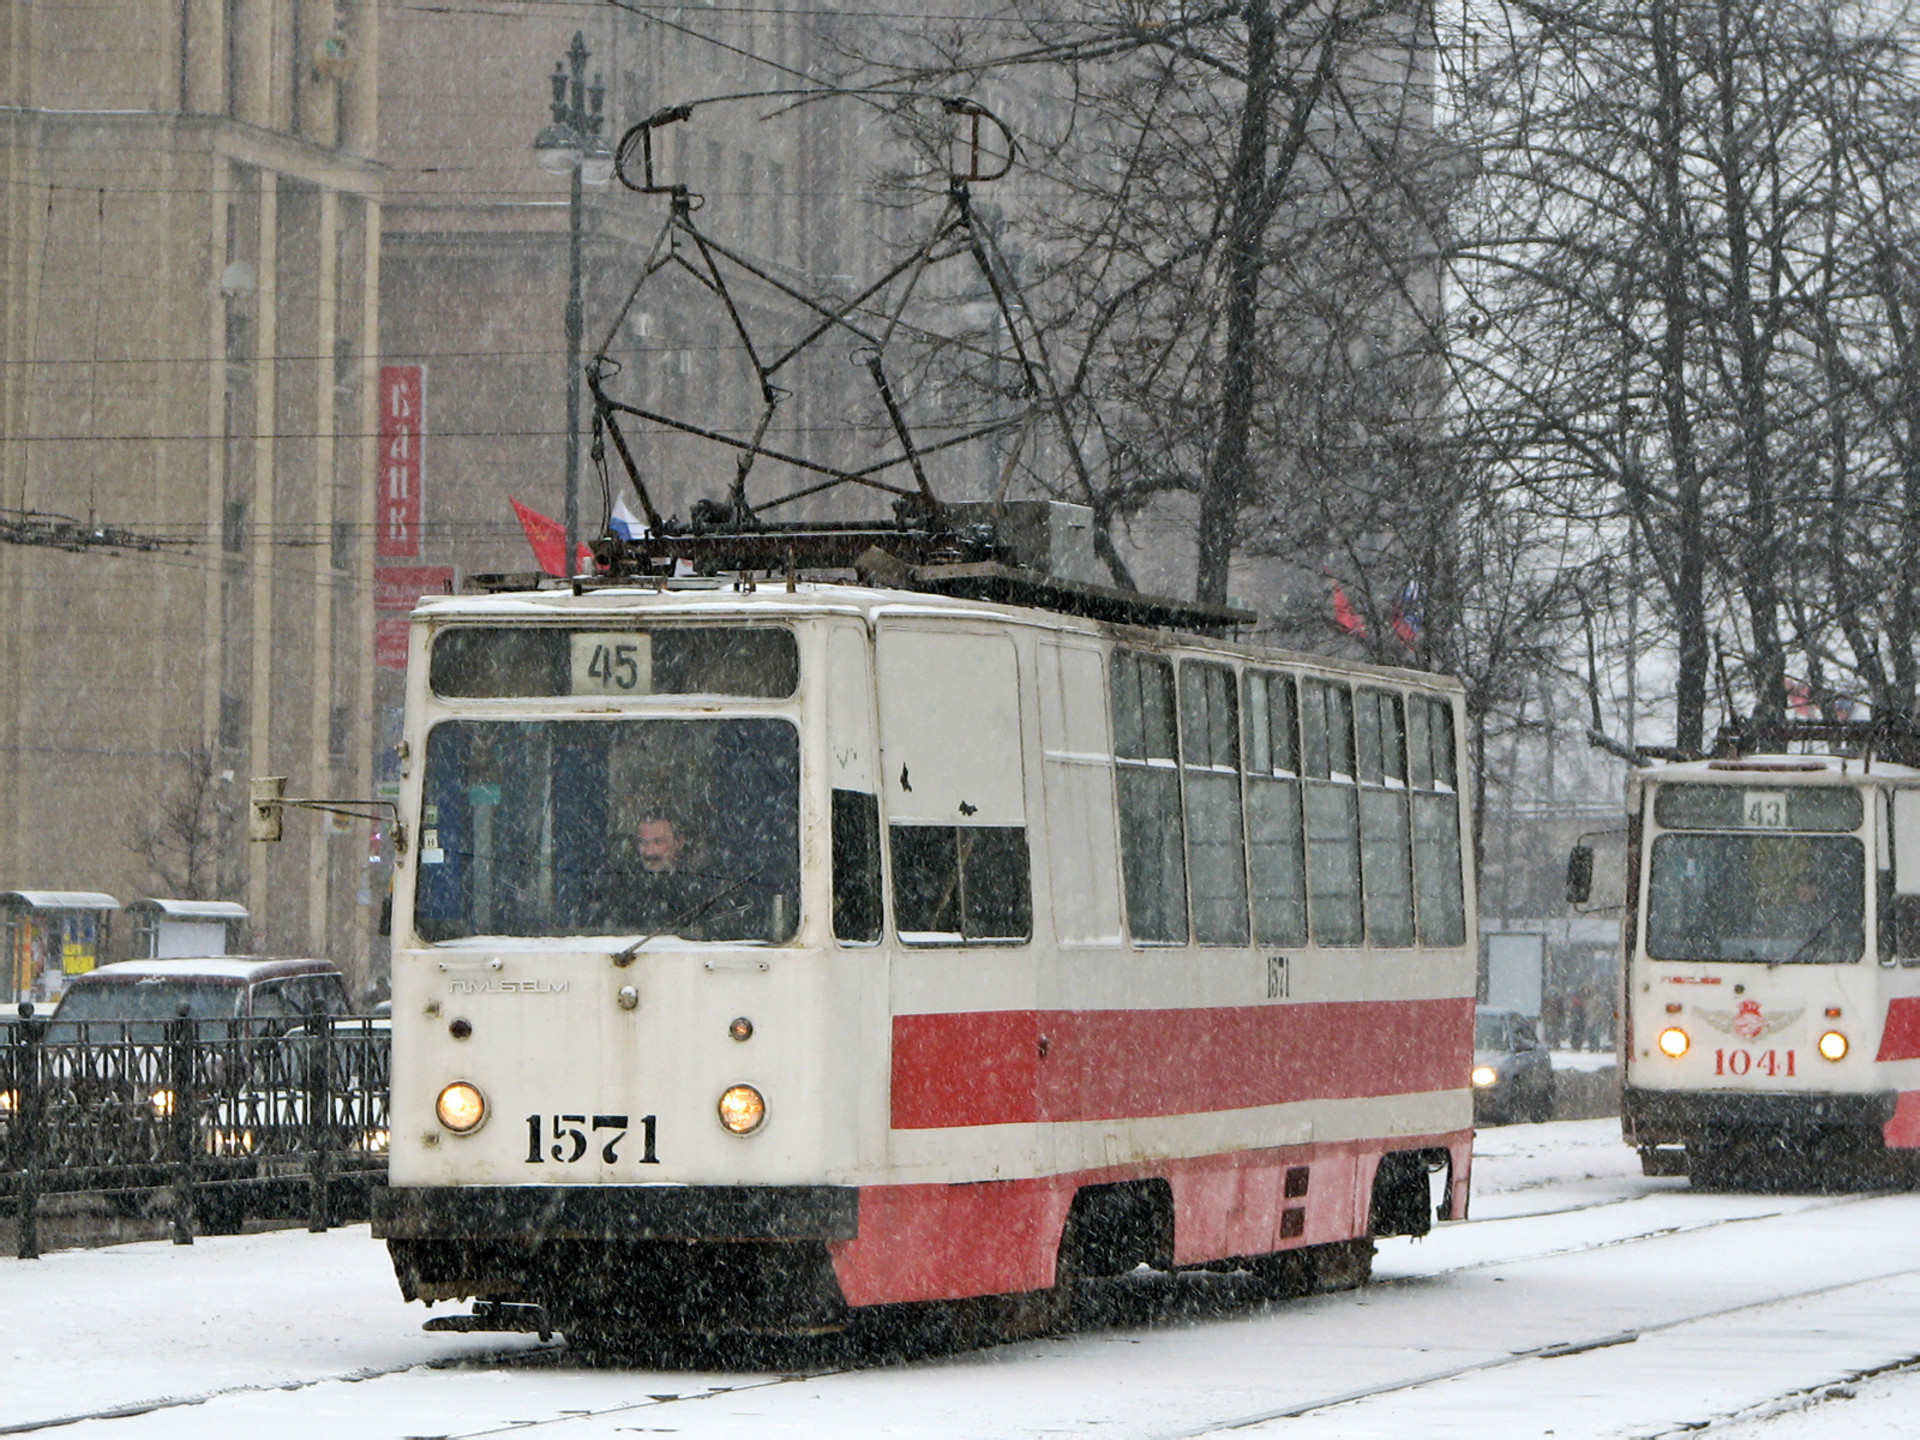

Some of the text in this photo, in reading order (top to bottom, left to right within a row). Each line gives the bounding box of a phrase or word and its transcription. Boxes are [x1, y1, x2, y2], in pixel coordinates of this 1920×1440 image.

[389, 383, 410, 540] БАНК
[588, 644, 638, 690] 45
[1749, 800, 1780, 827] 43
[1267, 956, 1290, 999] 1571
[1714, 1048, 1797, 1077] 1041
[524, 1114, 660, 1165] 1571
